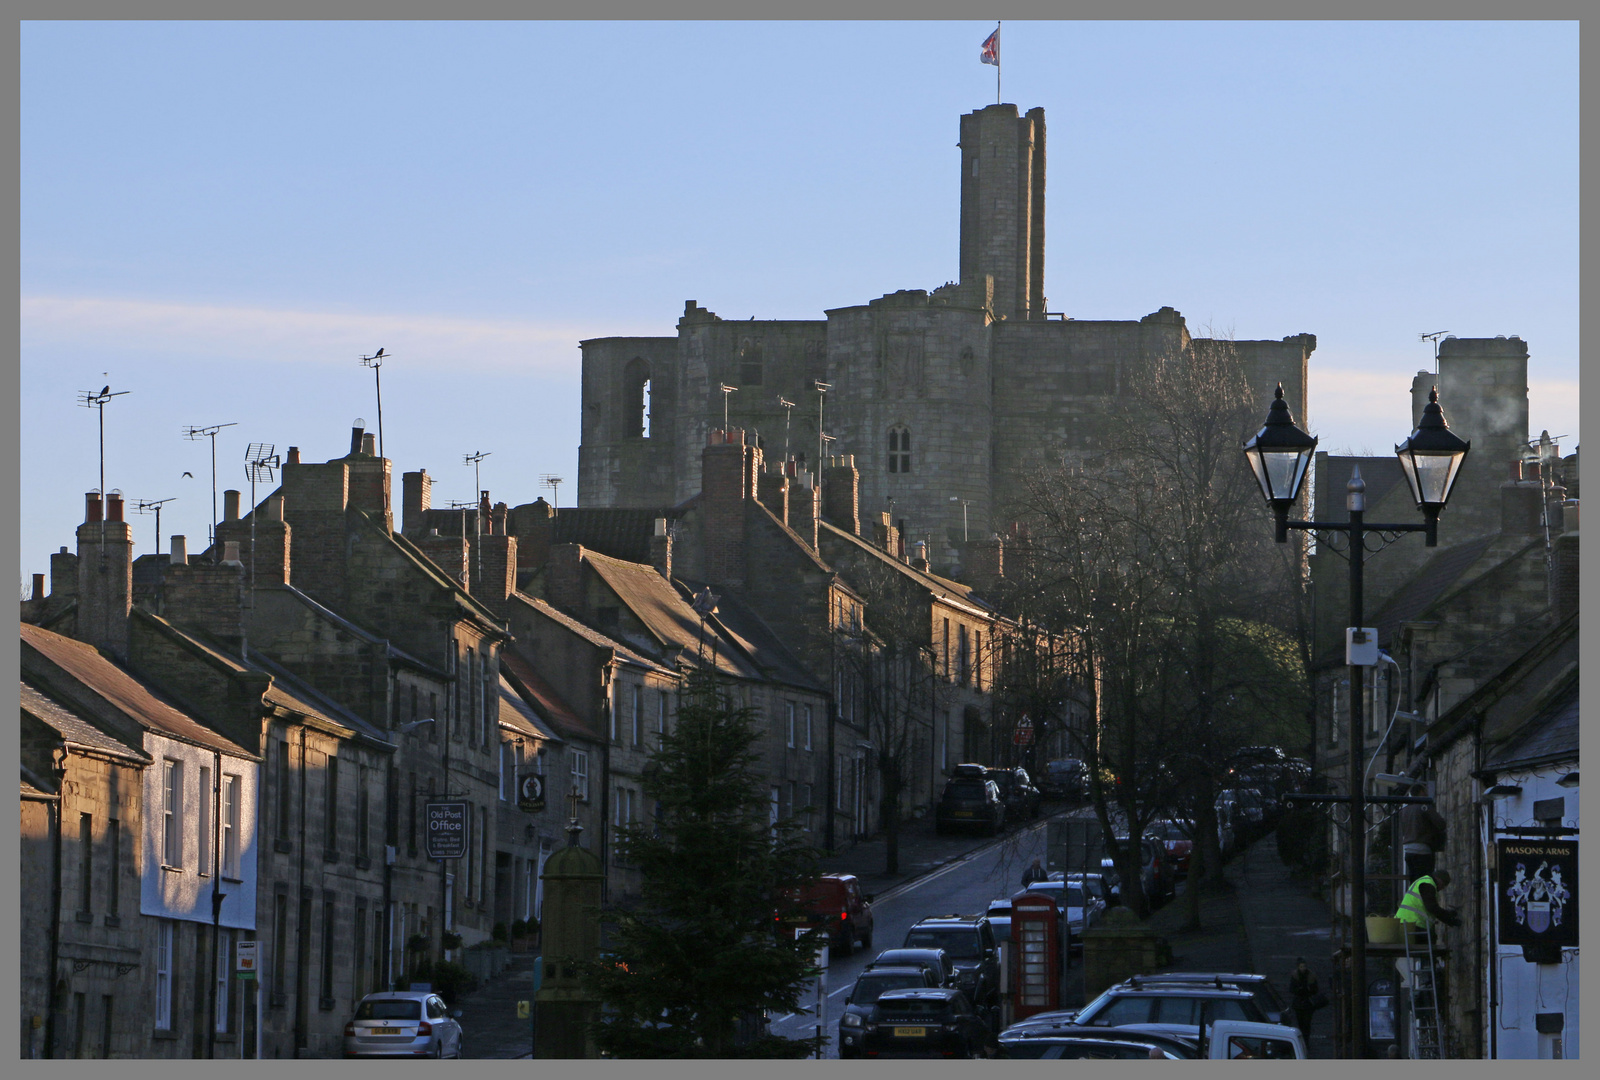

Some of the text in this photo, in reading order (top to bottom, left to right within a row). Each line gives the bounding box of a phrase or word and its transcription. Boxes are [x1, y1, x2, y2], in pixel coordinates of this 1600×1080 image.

[430, 811, 462, 819] Old Post
[430, 820, 462, 831] Office
[1505, 846, 1571, 856] MASONS ARMS
